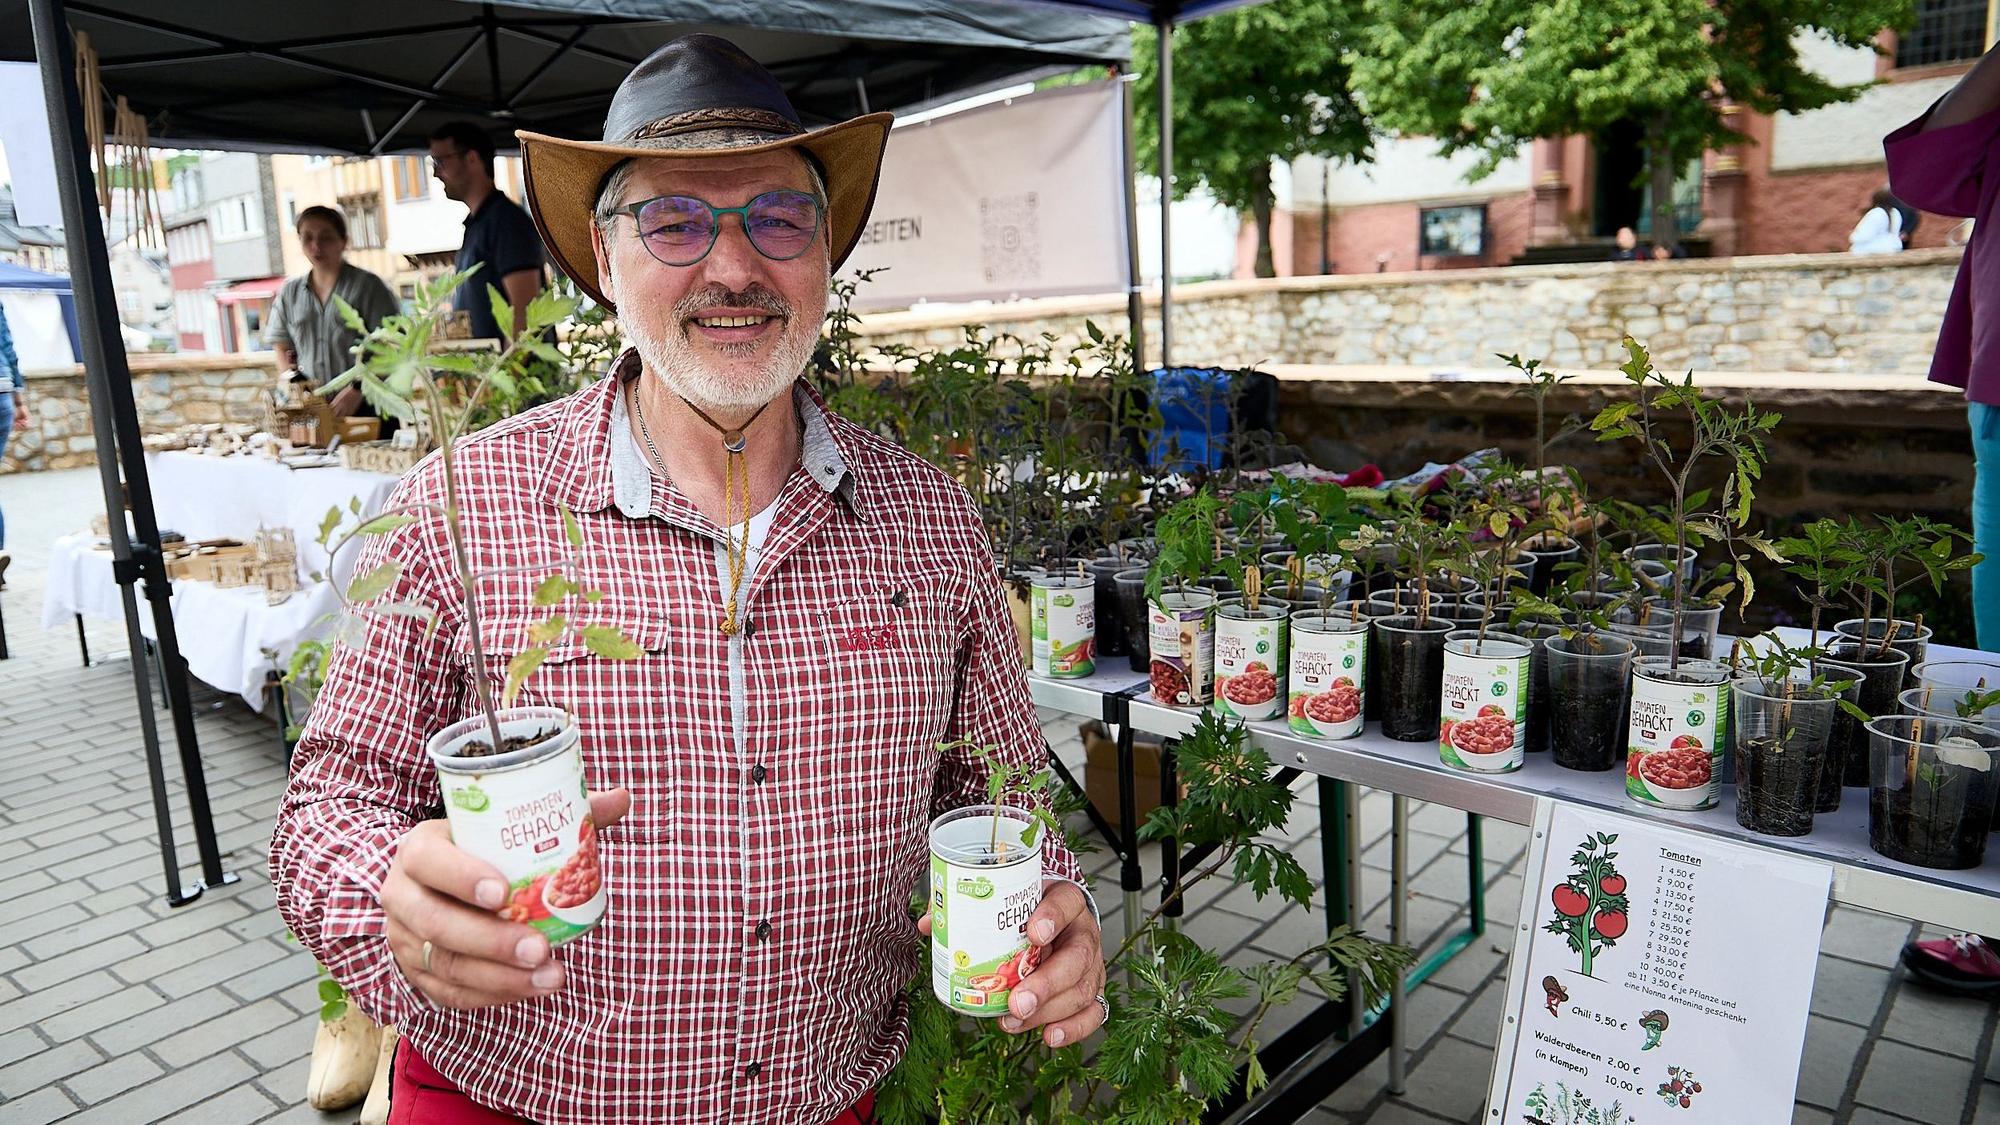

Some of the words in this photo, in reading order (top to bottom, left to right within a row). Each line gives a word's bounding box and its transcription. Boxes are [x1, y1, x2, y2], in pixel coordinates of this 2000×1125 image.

[504, 789, 563, 825] TOMATEN
[500, 801, 574, 851] GEHACKT
[1660, 847, 1702, 865] Tomaten
[1689, 872, 1696, 880] €
[1656, 886, 1660, 894] 3
[1652, 908, 1658, 916] 5
[1688, 906, 1694, 914] €
[1684, 940, 1690, 948] €
[1640, 962, 1649, 970] 10
[1646, 952, 1650, 960] 9
[1680, 962, 1686, 970] €
[1640, 974, 1646, 982] 11
[1678, 986, 1687, 994] je
[1689, 988, 1719, 1003] Pflanze
[1722, 1000, 1736, 1008] und
[1624, 982, 1640, 992] eine
[1642, 986, 1666, 999] Nonna
[1668, 994, 1703, 1010] Antonina
[1704, 1007, 1748, 1024] geschenkt
[1572, 1006, 1592, 1019] Chili
[1620, 1022, 1628, 1030] €
[1534, 1030, 1602, 1062] Walderdbeeren
[1633, 1066, 1640, 1074] €
[1535, 1048, 1546, 1060] (in
[1549, 1054, 1588, 1077] Klompen)
